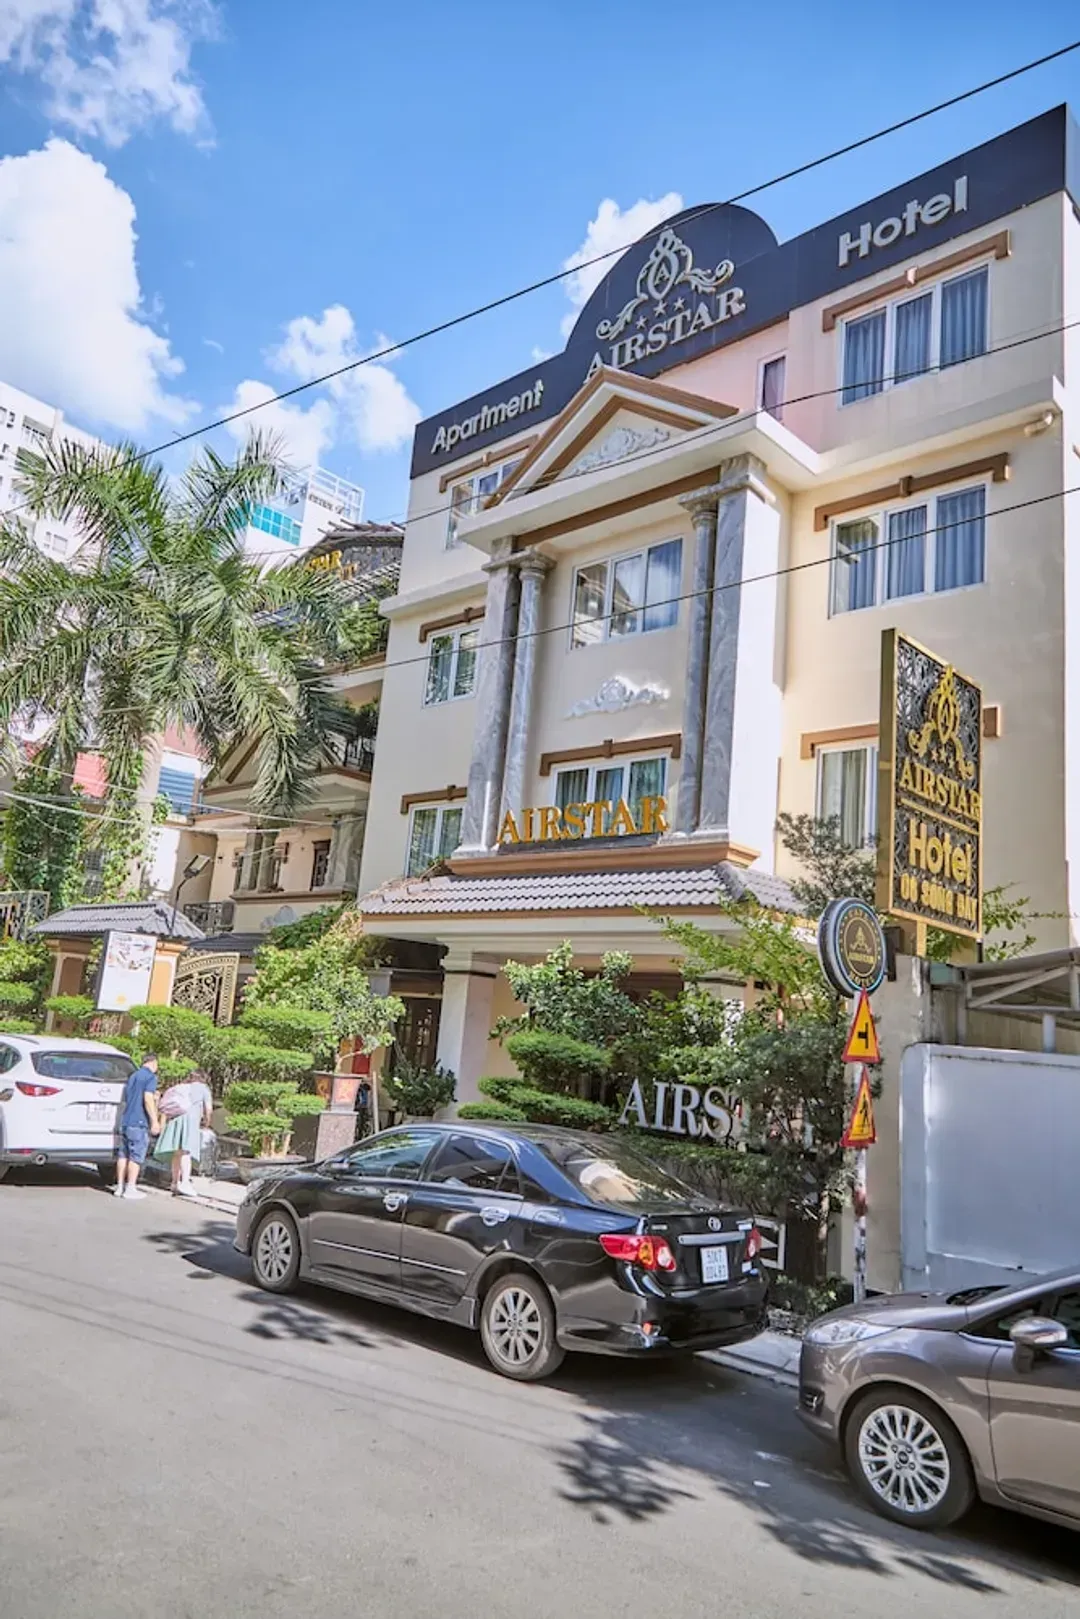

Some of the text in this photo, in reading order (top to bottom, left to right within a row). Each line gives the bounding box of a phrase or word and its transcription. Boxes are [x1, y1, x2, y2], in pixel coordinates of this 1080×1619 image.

[838, 175, 968, 267] Hotel
[583, 286, 747, 384] AIRSTAR
[430, 379, 544, 454] Apartment
[496, 795, 670, 845] AIRSTAR
[899, 757, 981, 822] AIRSTAR
[908, 818, 973, 887] Hotel
